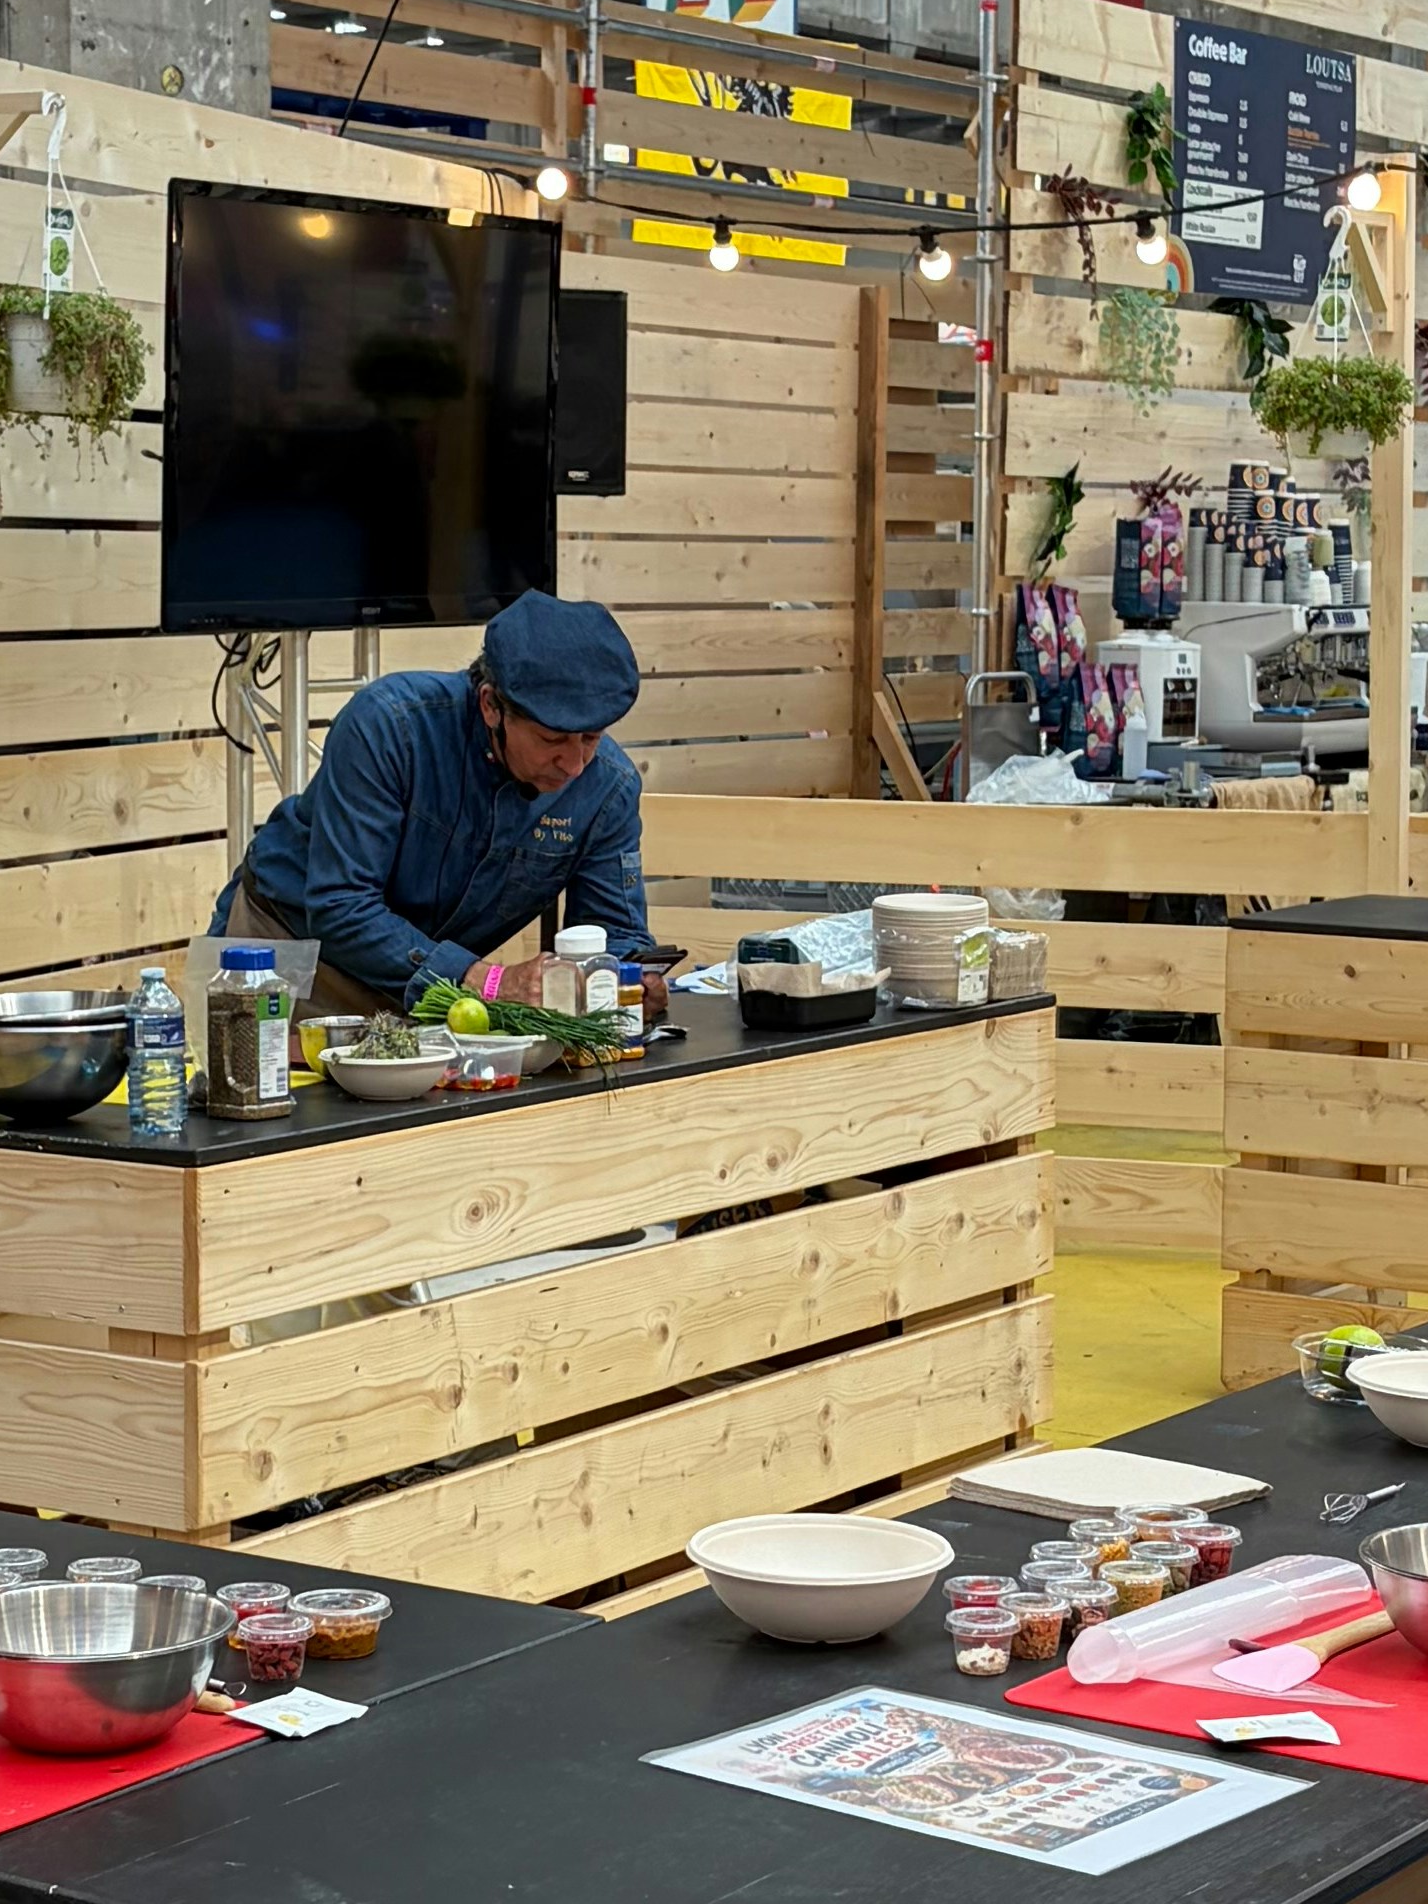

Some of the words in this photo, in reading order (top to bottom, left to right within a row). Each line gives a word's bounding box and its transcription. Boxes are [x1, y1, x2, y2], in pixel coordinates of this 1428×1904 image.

[1188, 34, 1228, 63] Coffee
[1229, 41, 1248, 66] Bar
[1306, 53, 1353, 84] LOUTSA
[739, 1731, 788, 1755] LYON
[776, 1728, 829, 1756] STREET
[825, 1715, 858, 1736] FOOD
[789, 1720, 889, 1768] CANNOLI
[835, 1729, 916, 1768] SALES
